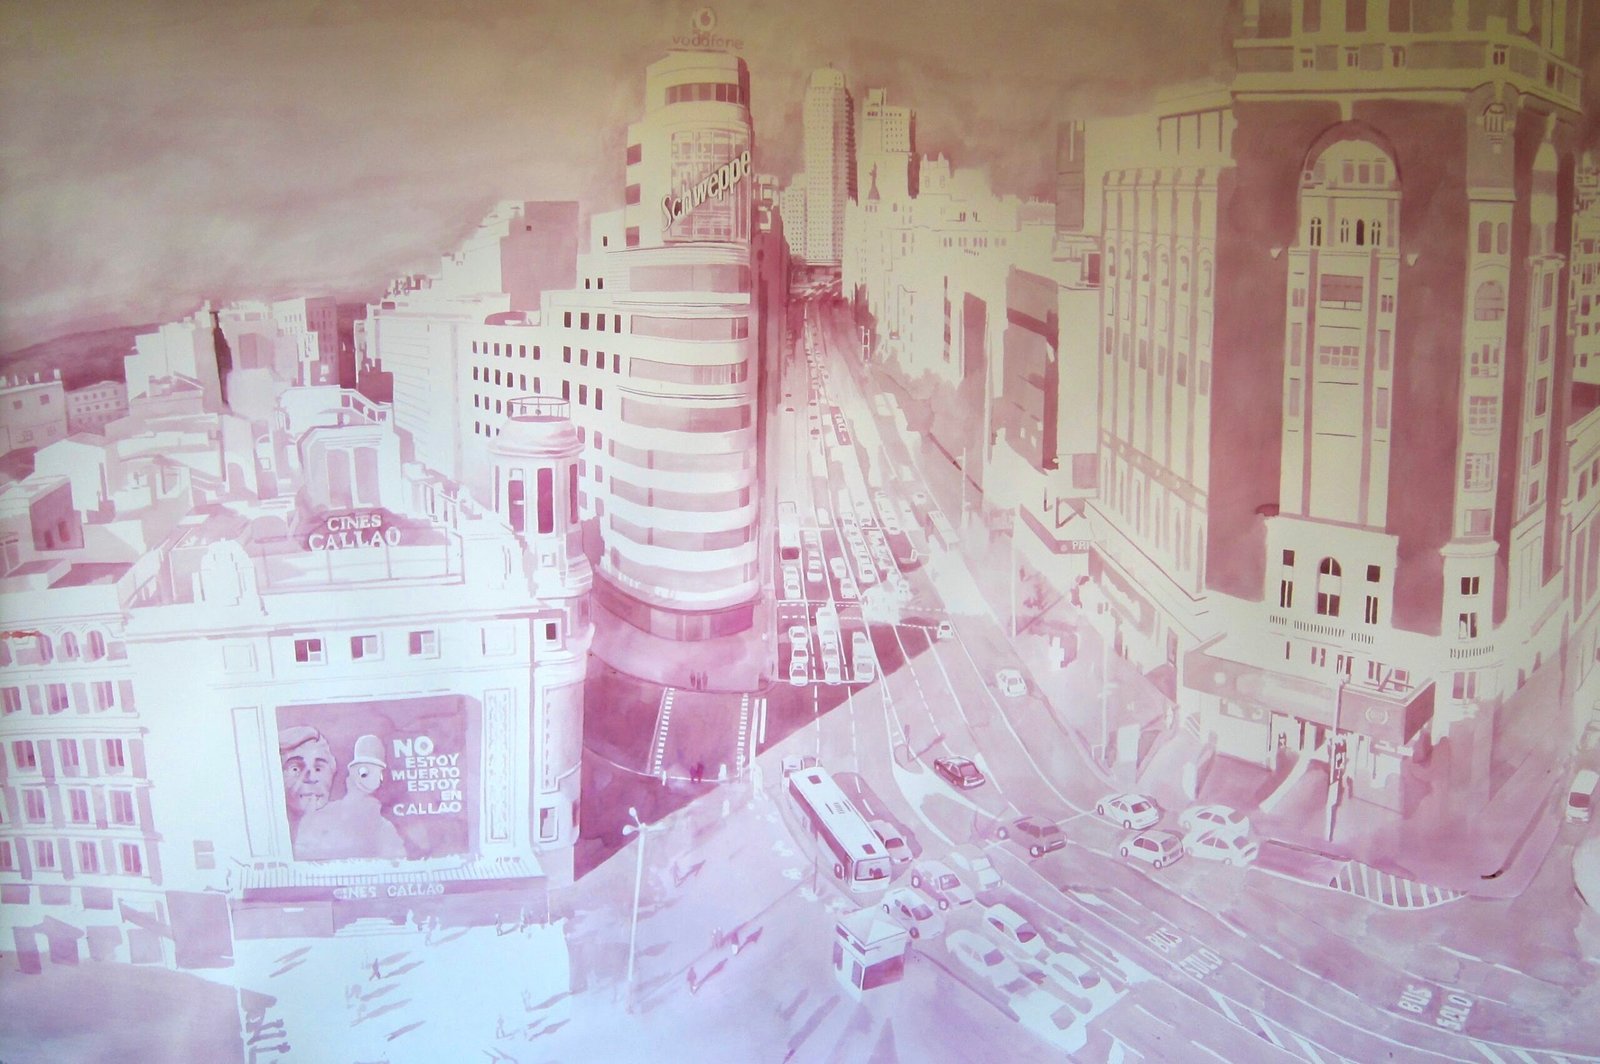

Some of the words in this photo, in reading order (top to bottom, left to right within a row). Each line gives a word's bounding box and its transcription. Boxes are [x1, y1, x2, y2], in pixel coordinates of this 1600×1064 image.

[672, 32, 745, 50] vodafone
[327, 513, 382, 531] CINES
[308, 526, 401, 550] CALLAO
[393, 735, 434, 758] NO
[405, 752, 459, 768] ESTOY
[391, 766, 460, 781] MUERTO
[407, 778, 460, 792] ESTOY
[441, 790, 462, 801] EN
[392, 801, 462, 816] CALLAO
[333, 885, 377, 899] CINES
[386, 883, 445, 897] CALLAO
[1397, 984, 1432, 1013] BUS
